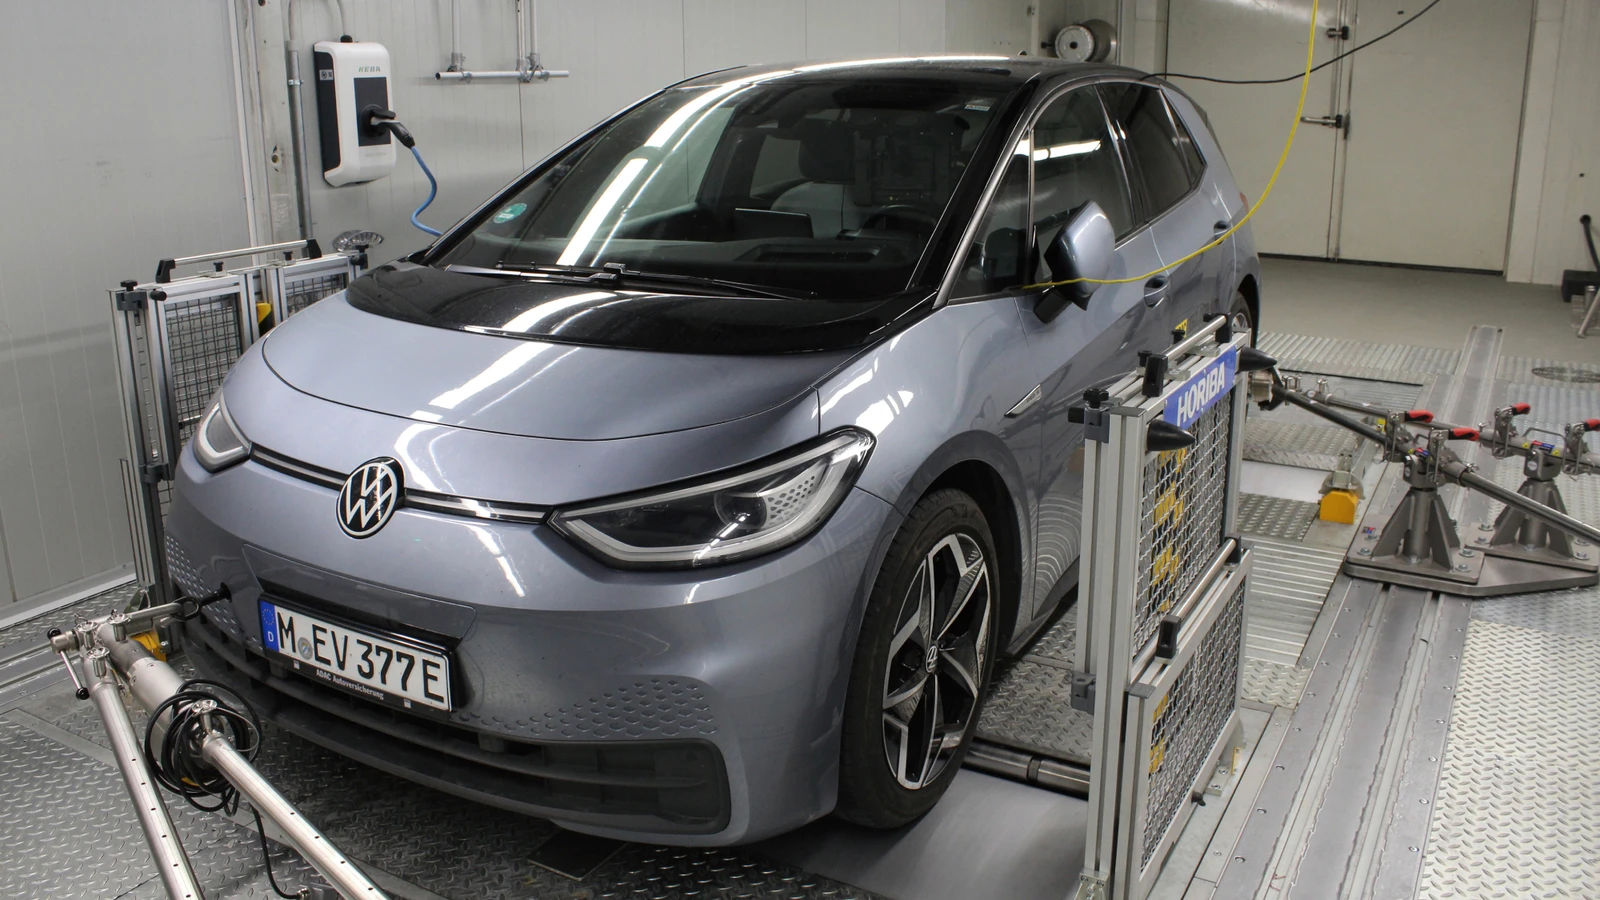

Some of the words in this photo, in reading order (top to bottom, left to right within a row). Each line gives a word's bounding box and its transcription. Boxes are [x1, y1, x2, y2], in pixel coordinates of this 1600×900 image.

[358, 65, 381, 73] KEBA
[1176, 361, 1225, 427] HORIBA
[267, 631, 274, 642] D
[277, 611, 297, 653] M
[312, 623, 349, 671] EV
[356, 638, 445, 704] 377E
[316, 668, 332, 681] ADAC
[332, 675, 385, 700] Autoversicherung
